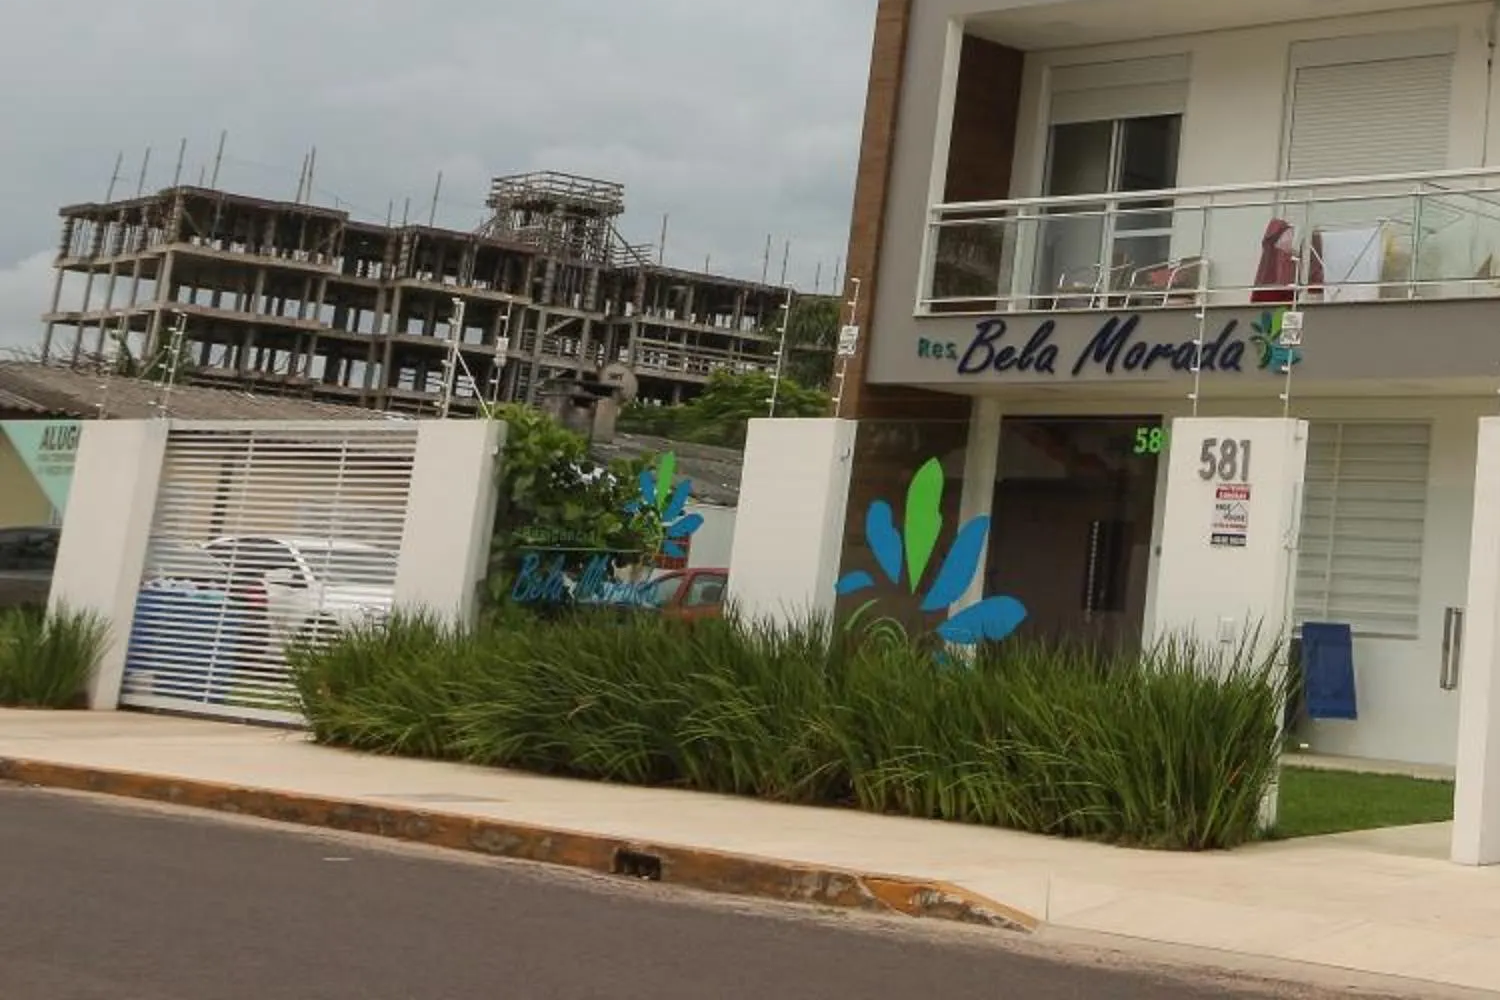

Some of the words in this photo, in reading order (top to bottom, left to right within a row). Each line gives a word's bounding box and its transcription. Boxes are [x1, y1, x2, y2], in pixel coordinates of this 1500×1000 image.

[957, 319, 1059, 374] Bela
[1072, 314, 1245, 376] Morada
[39, 425, 81, 450] ALUG
[1198, 438, 1251, 482] 581
